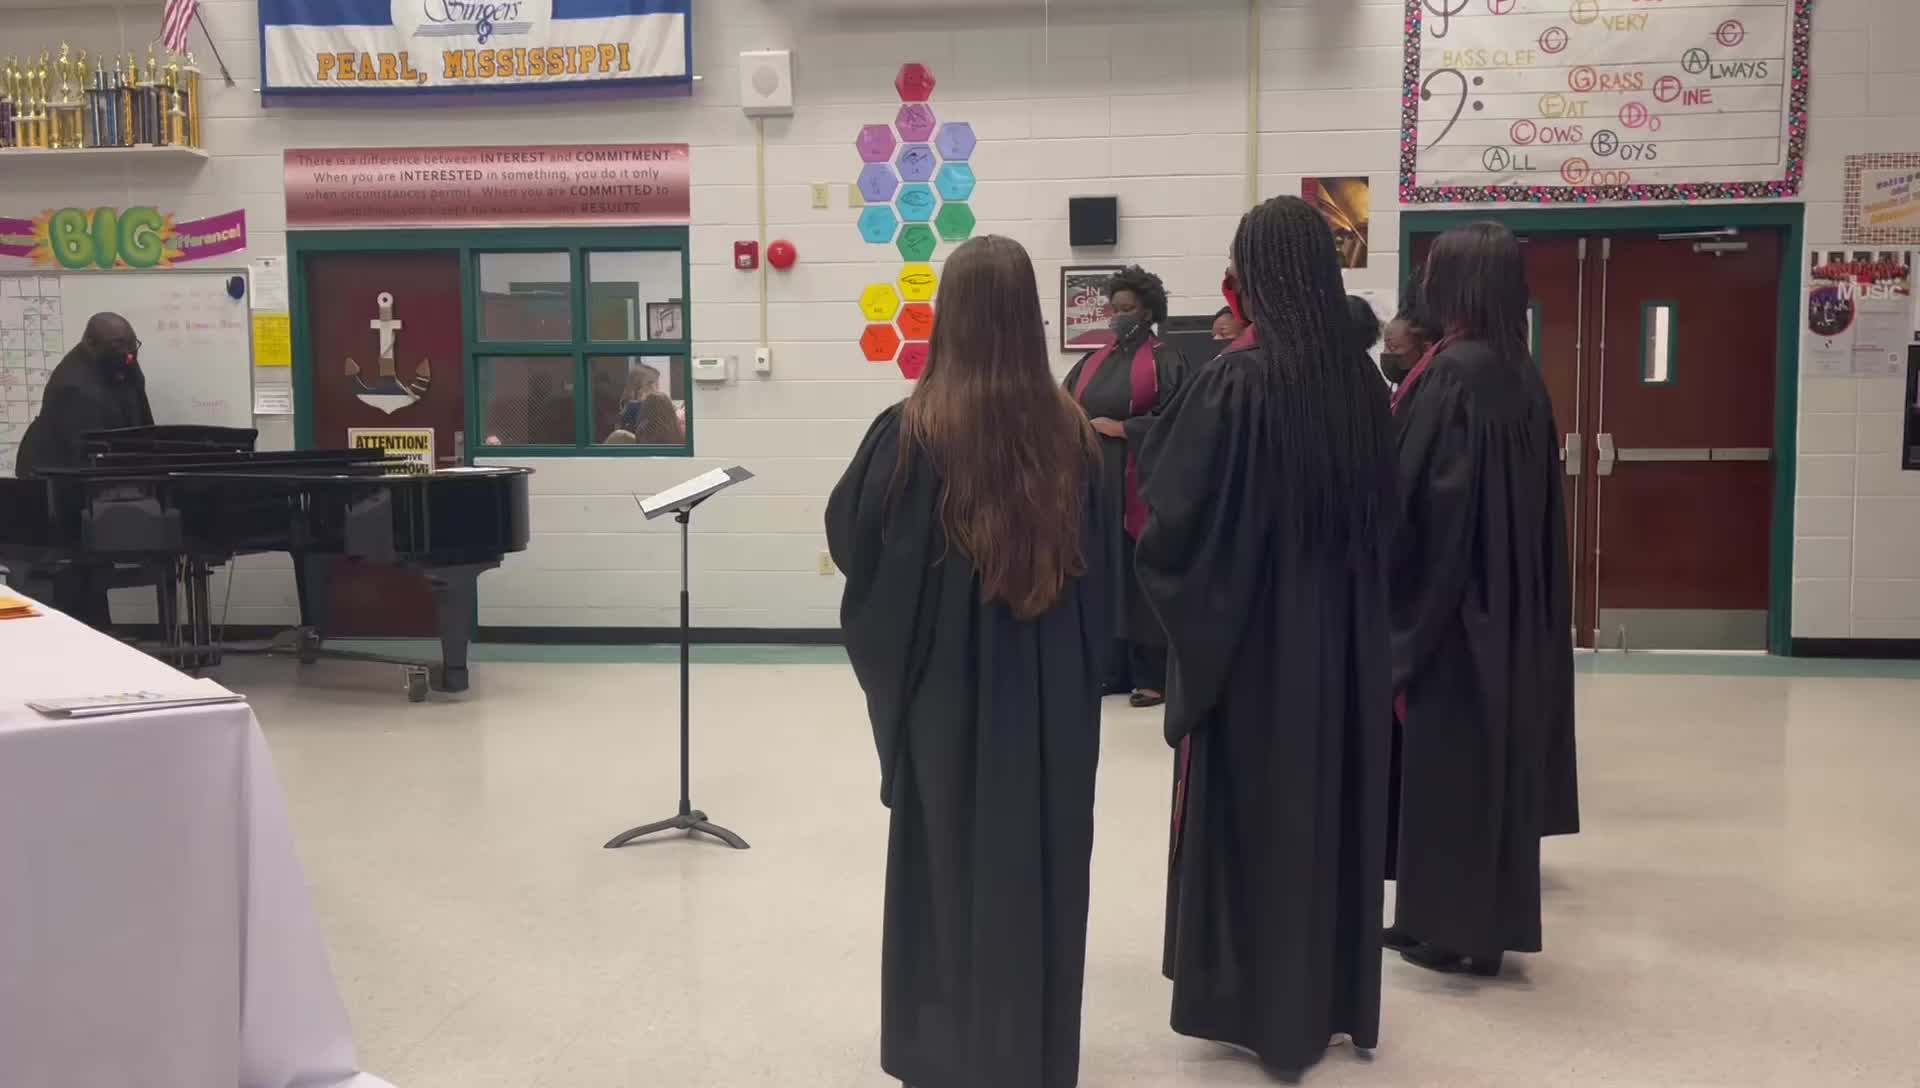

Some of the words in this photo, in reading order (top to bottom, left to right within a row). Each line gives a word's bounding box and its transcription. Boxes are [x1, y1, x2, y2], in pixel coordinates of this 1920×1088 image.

[317, 51, 427, 84] PEARL,
[443, 43, 631, 80] MISSISSIPPI
[1443, 50, 1486, 67] BASS
[1492, 49, 1537, 66] CLEF
[1681, 48, 1768, 80] ALWAYS
[1568, 65, 1643, 92] GRASS
[1653, 75, 1713, 106] FINE
[1539, 93, 1588, 118] EAT
[1618, 102, 1661, 132] DO
[1510, 119, 1583, 145] COWS
[1590, 130, 1657, 160] BOYS
[298, 155, 332, 167] There
[336, 154, 345, 166] is
[360, 153, 422, 166] difference
[424, 153, 477, 165] between
[481, 152, 545, 163] INTEREST
[550, 151, 572, 162] and
[1482, 146, 1536, 172] ALL
[1560, 157, 1631, 186] GOOD
[313, 172, 347, 183] When
[351, 173, 373, 185] you
[377, 173, 396, 183] are
[400, 170, 482, 182] INTERESTED
[487, 168, 497, 180] in
[501, 168, 570, 183] something,
[575, 170, 597, 183] you
[601, 168, 616, 179] do
[620, 168, 628, 178] it
[633, 167, 659, 181] only
[305, 188, 337, 200] when
[482, 186, 516, 198] When
[521, 188, 543, 201] you
[547, 188, 566, 198] are
[570, 185, 653, 196] COMMITTED
[657, 184, 669, 196] to
[49, 206, 162, 269] BIG
[1074, 295, 1110, 306] GOD
[1087, 286, 1101, 297] IN
[1837, 281, 1903, 301] Music
[356, 435, 428, 450] ATTENTION!
